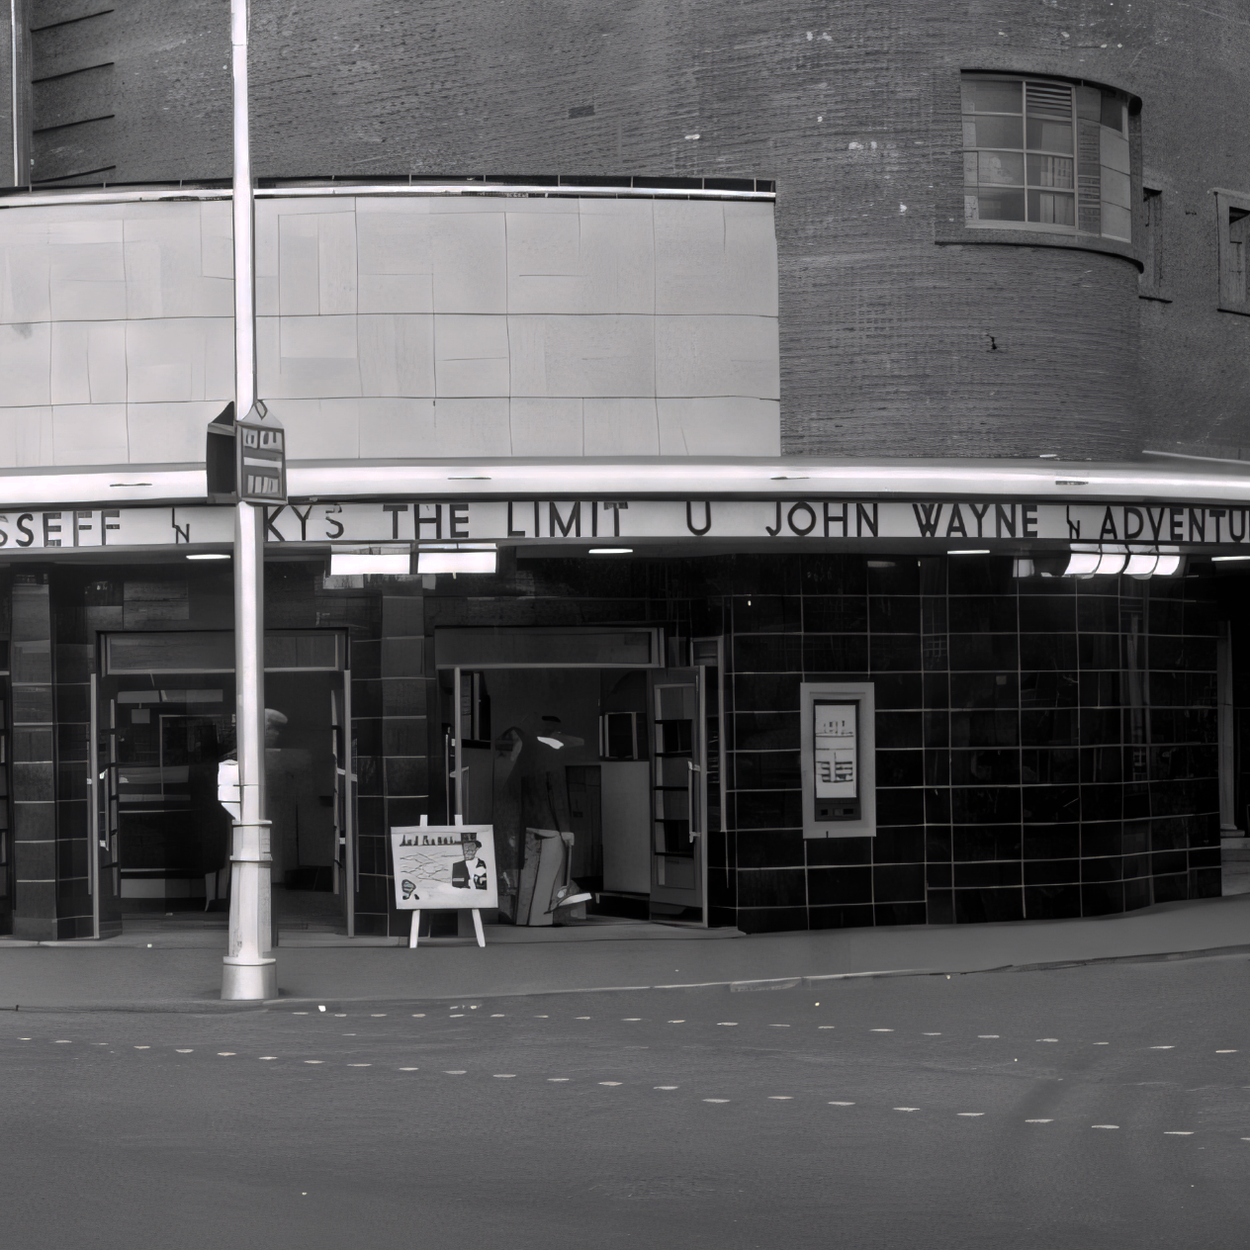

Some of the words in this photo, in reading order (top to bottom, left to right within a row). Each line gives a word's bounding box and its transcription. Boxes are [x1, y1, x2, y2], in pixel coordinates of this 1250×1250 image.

[262, 503, 345, 544] KYS
[383, 502, 470, 541] THE
[506, 501, 629, 538] LIMIT
[685, 500, 712, 537] U
[765, 500, 880, 538] JOHN
[911, 502, 1039, 539] WAYNE
[1100, 505, 1250, 544] ADVENTU
